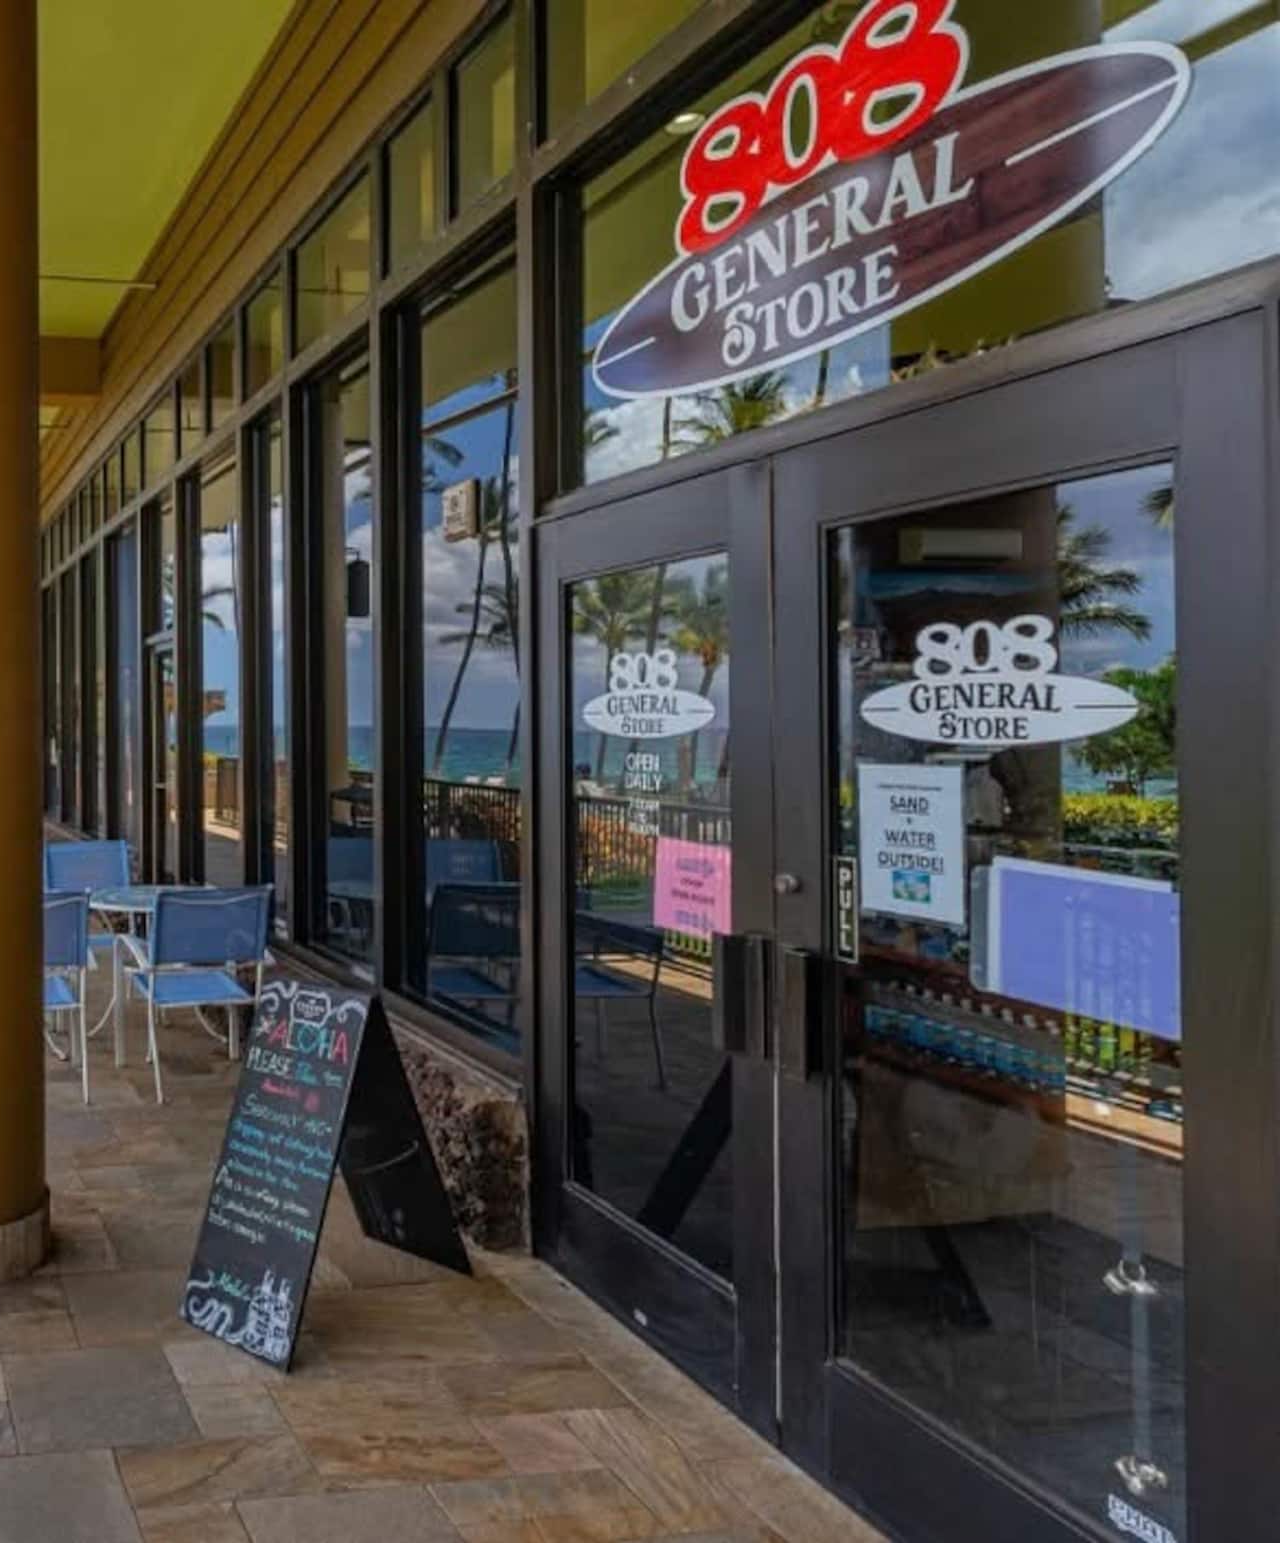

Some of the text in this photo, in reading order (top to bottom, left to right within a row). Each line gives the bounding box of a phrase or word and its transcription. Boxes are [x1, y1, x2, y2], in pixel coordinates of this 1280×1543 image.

[675, 0, 969, 254] 808
[670, 131, 975, 331] GENERAL
[720, 244, 902, 367] STORE
[913, 615, 1057, 680] 808
[609, 649, 677, 692] 808
[607, 694, 680, 717] GENERAL
[909, 682, 1061, 713] GENERAL
[939, 713, 1028, 740] STORE
[625, 752, 659, 772] OPEN
[624, 772, 662, 792] DAILY
[890, 794, 929, 814] SAND
[884, 829, 936, 847] WATER
[838, 866, 852, 951] PULL
[267, 1017, 348, 1064] ALOHA
[246, 1045, 293, 1080] PLEASE
